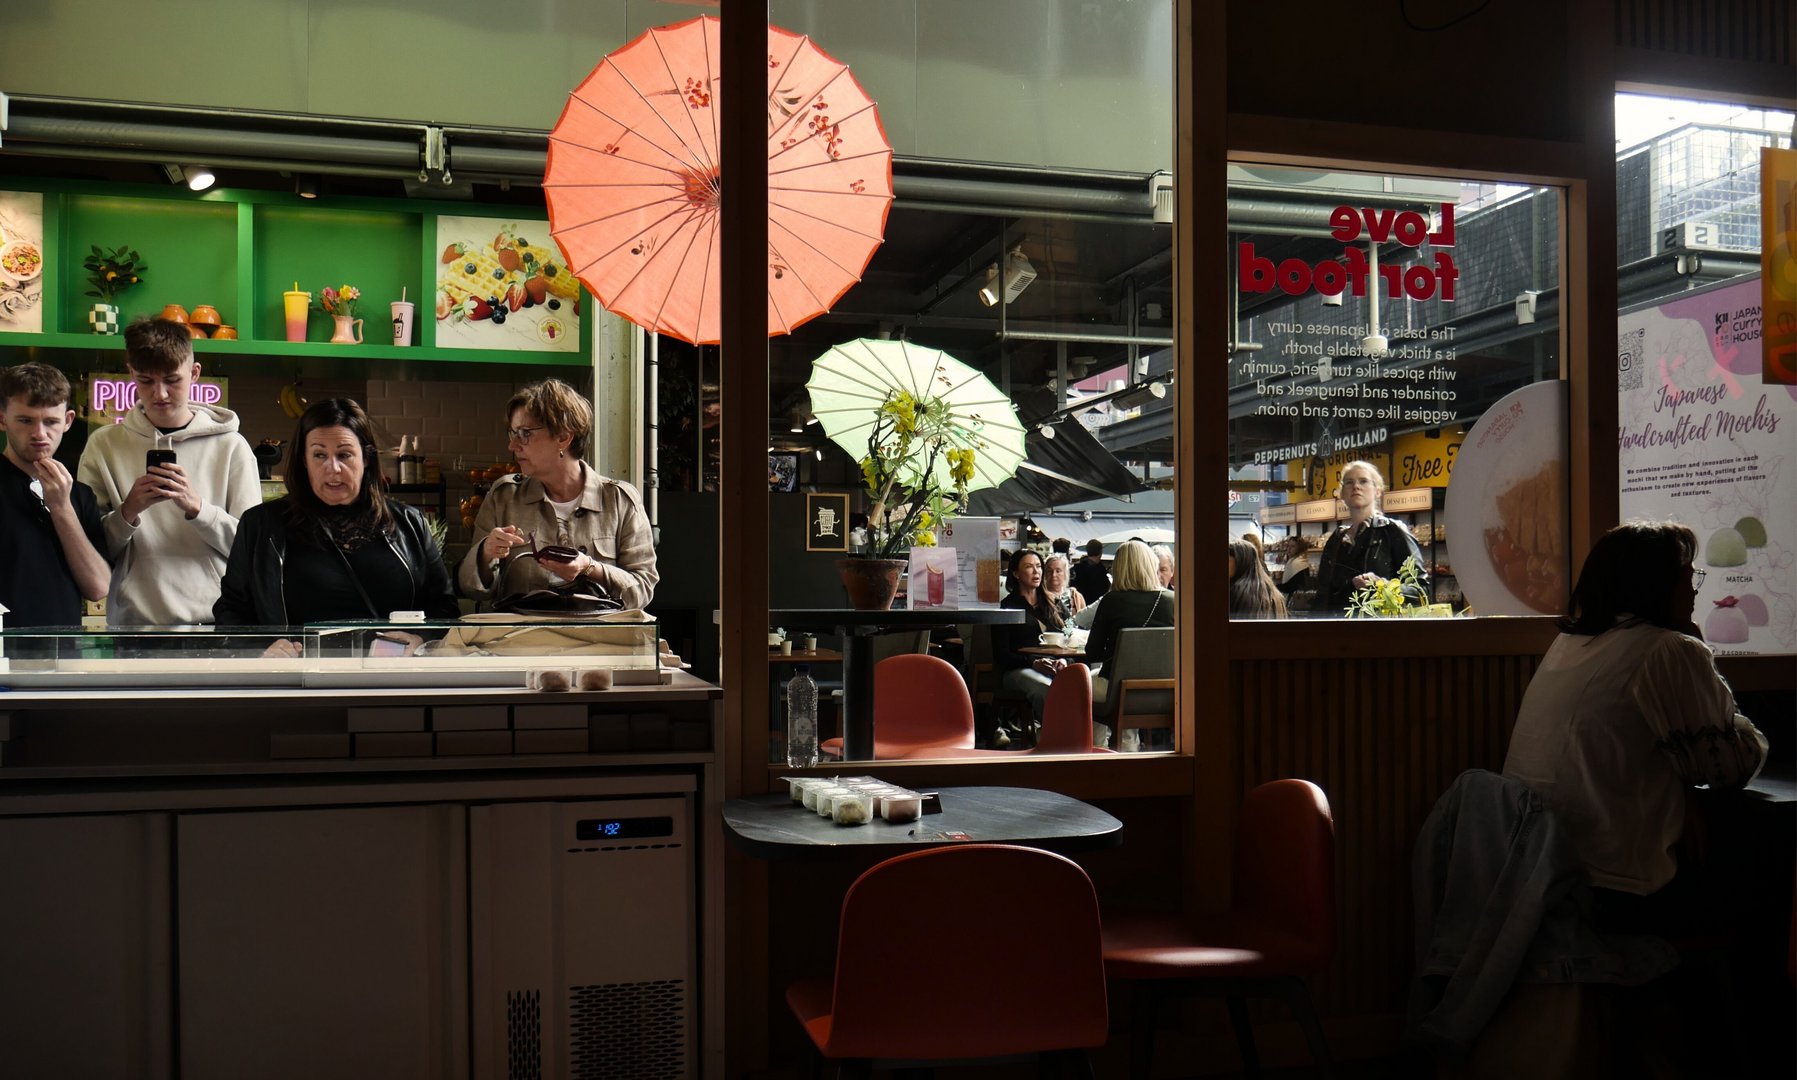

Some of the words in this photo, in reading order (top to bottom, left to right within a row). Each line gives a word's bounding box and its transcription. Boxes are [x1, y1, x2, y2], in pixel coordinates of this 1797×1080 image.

[1696, 226, 1707, 244] 2
[94, 380, 137, 412] PIC
[1654, 383, 1728, 417] Japanese
[1254, 443, 1318, 464] PEPPERNUTS
[1334, 427, 1388, 451] HOLLAND
[1402, 454, 1443, 486] Free
[1702, 458, 1734, 466] innovation
[1715, 468, 1736, 476] putting
[1696, 477, 1734, 486] experiences
